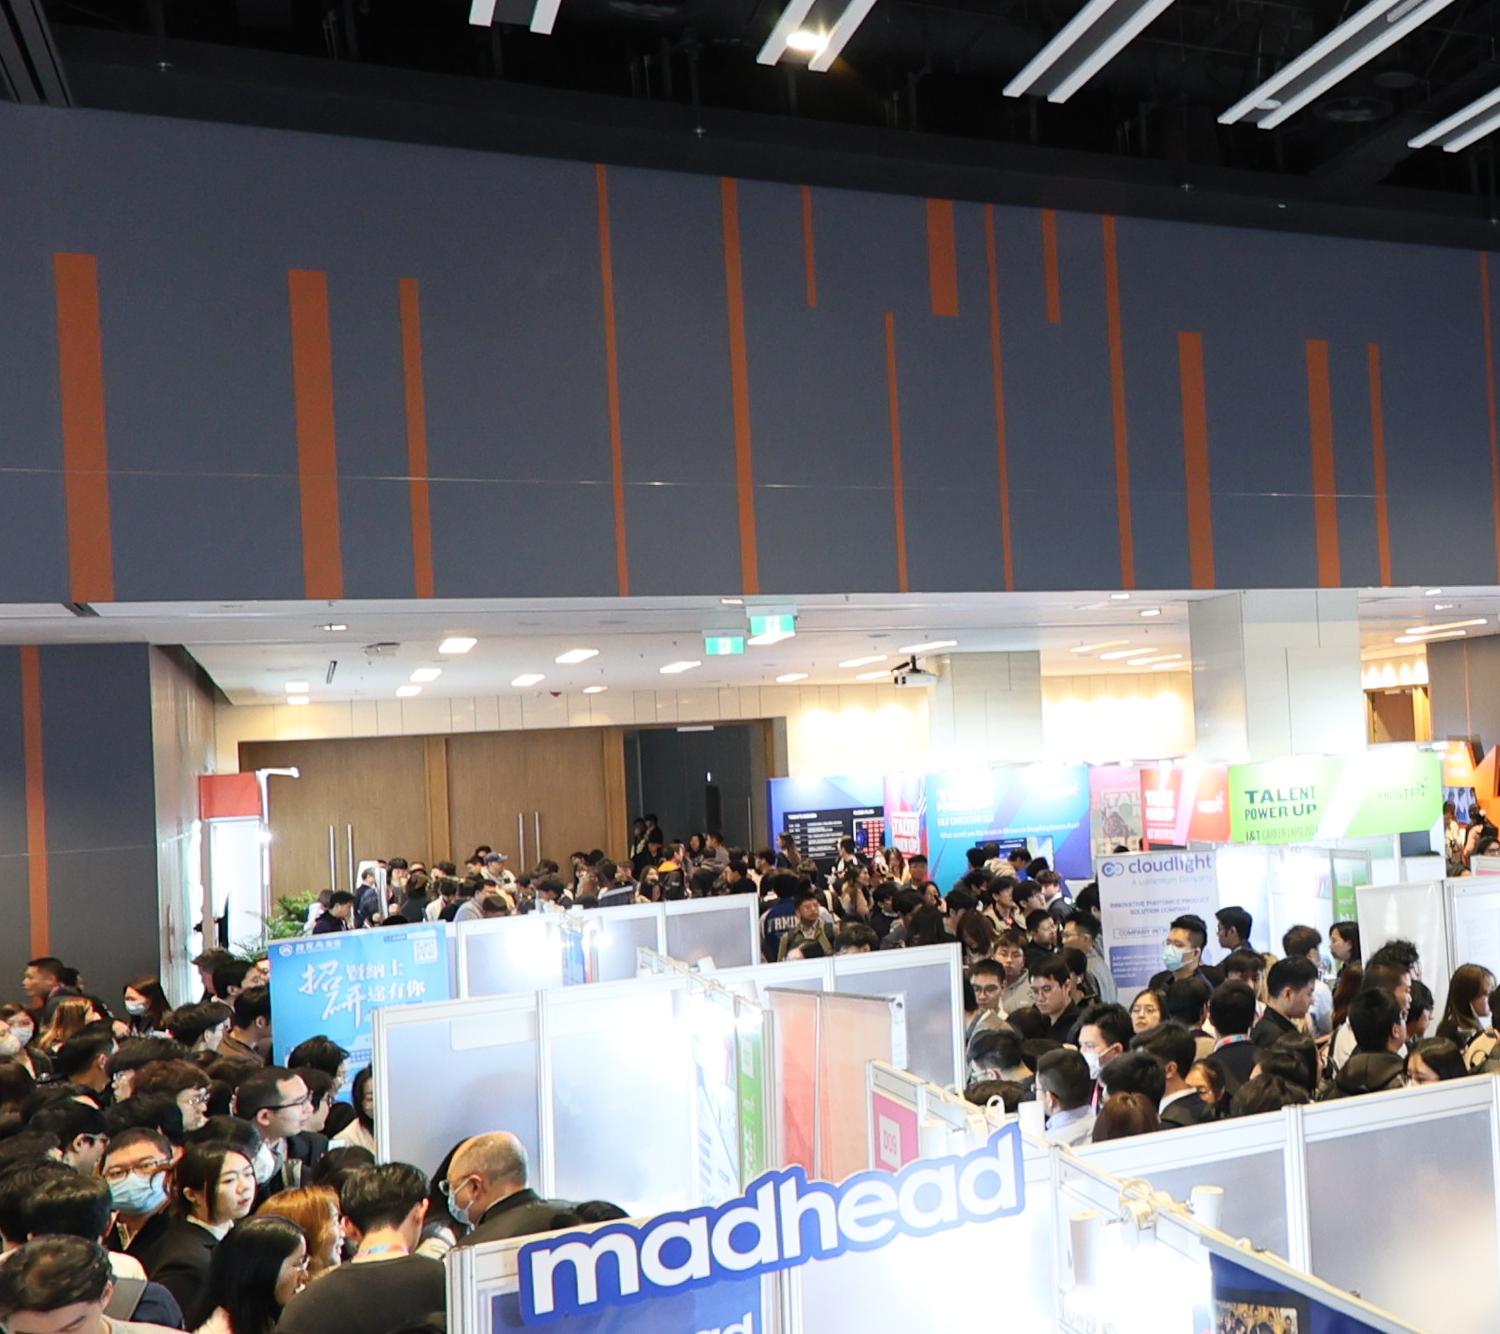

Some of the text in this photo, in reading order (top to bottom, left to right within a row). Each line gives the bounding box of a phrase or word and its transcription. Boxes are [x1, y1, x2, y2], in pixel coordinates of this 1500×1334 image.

[1244, 786, 1316, 804] TALENT
[1245, 803, 1317, 821] POWER UP
[1246, 829, 1260, 841] I&T
[1128, 855, 1212, 874] cloudlight
[883, 1129, 898, 1156] D09
[531, 1139, 1020, 1315] madhead
